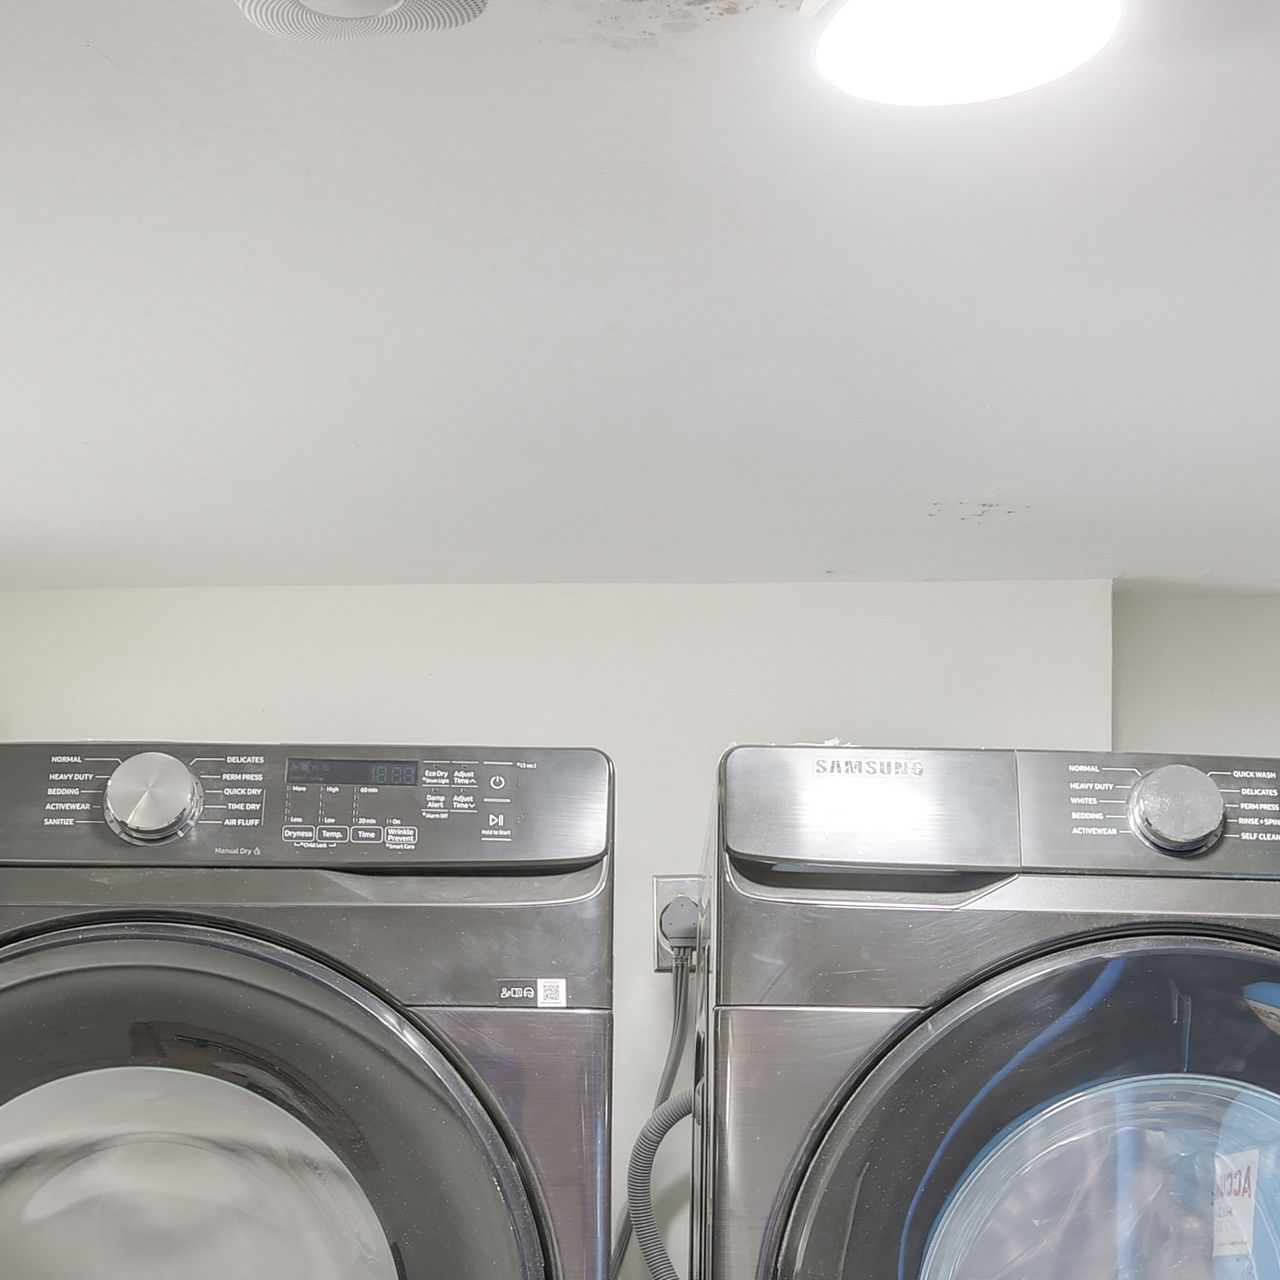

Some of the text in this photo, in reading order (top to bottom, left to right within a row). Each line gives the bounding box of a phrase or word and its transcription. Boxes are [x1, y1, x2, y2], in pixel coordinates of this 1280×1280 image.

[816, 760, 924, 776] SAMSUNG
[284, 828, 313, 838] Dryness
[322, 830, 343, 839] Temp.
[358, 830, 375, 838] Time
[240, 848, 252, 856] Dry
